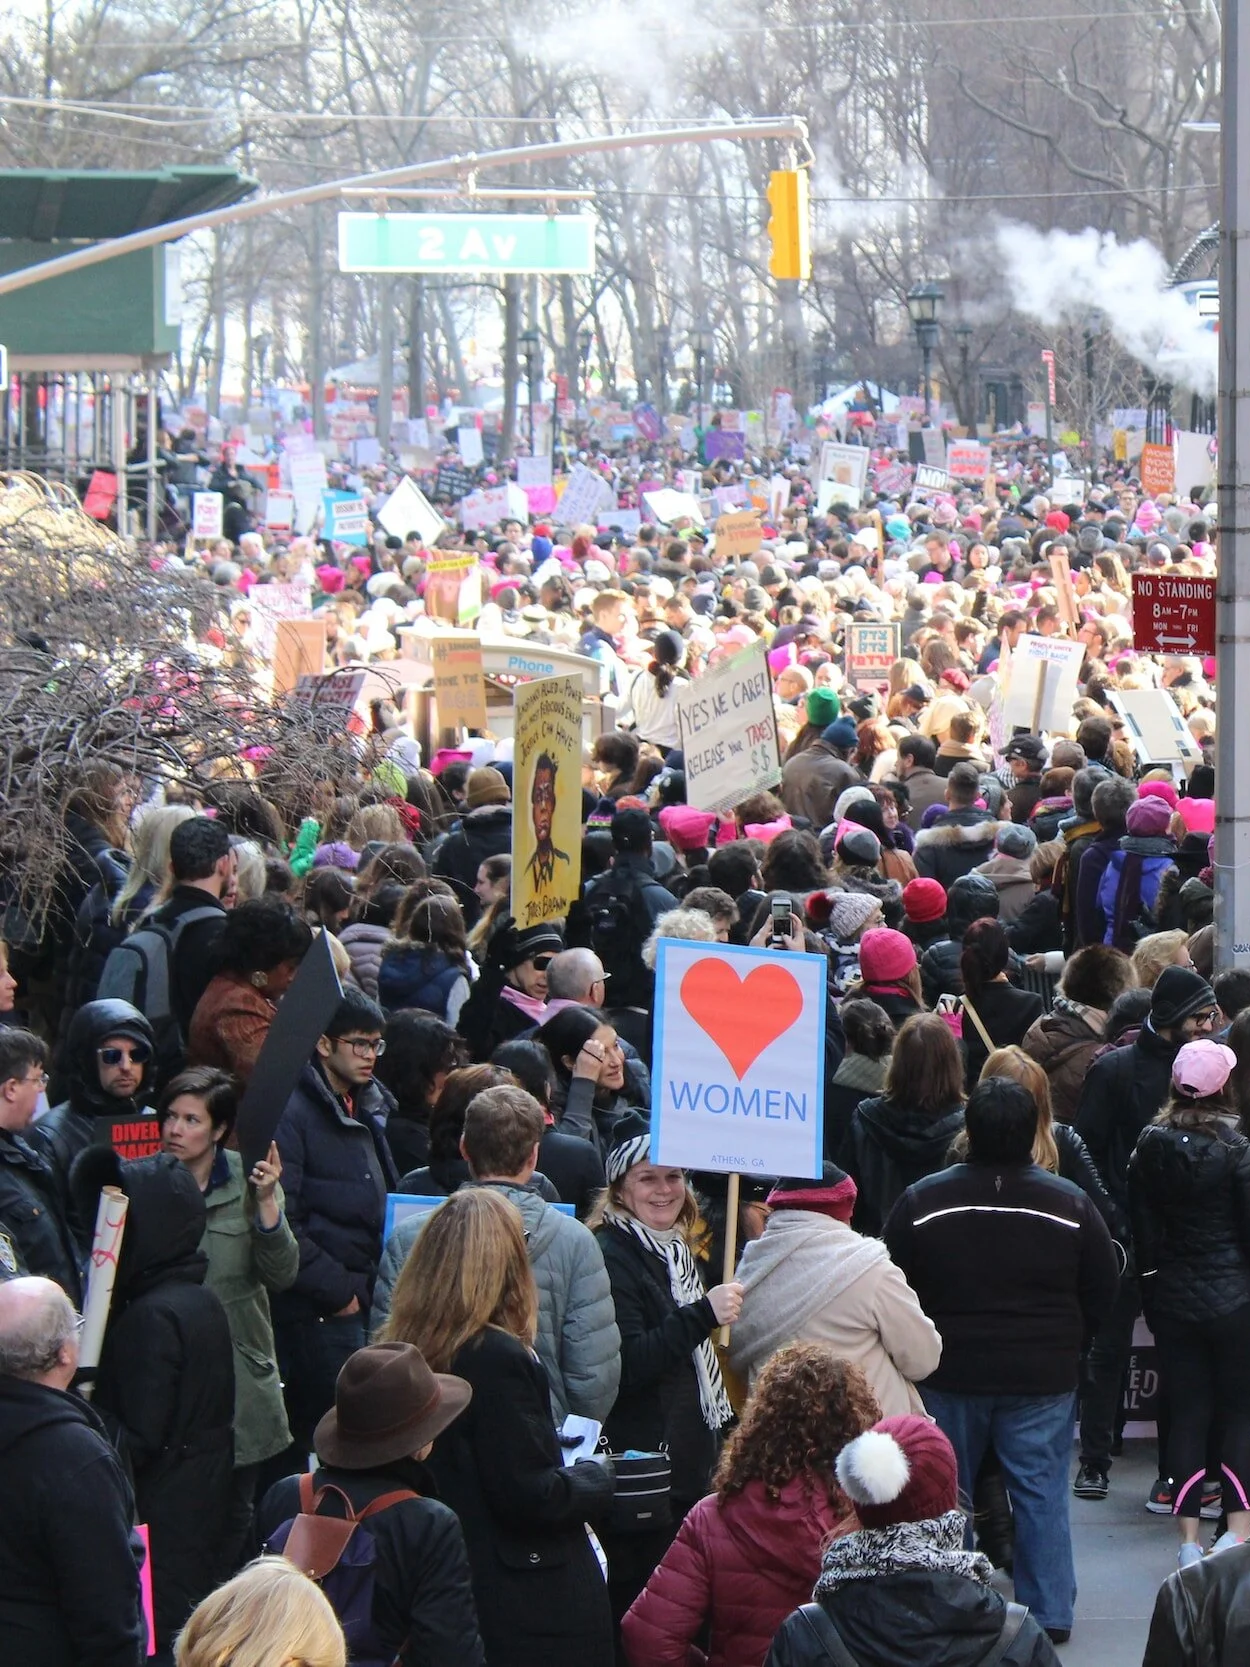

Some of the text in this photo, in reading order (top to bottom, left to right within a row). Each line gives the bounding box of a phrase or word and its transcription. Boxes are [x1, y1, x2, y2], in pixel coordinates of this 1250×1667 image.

[418, 227, 446, 260] 2
[1138, 581, 1212, 600] NO STANDING
[1153, 622, 1168, 631] MON
[1187, 624, 1198, 633] FRI
[508, 656, 554, 673] Phone
[732, 671, 766, 709] CARE!
[687, 740, 725, 782] RELEASE
[745, 715, 774, 747] TAXES
[669, 1080, 808, 1122] WOMEN
[711, 1155, 765, 1167] ATHENS, GA
